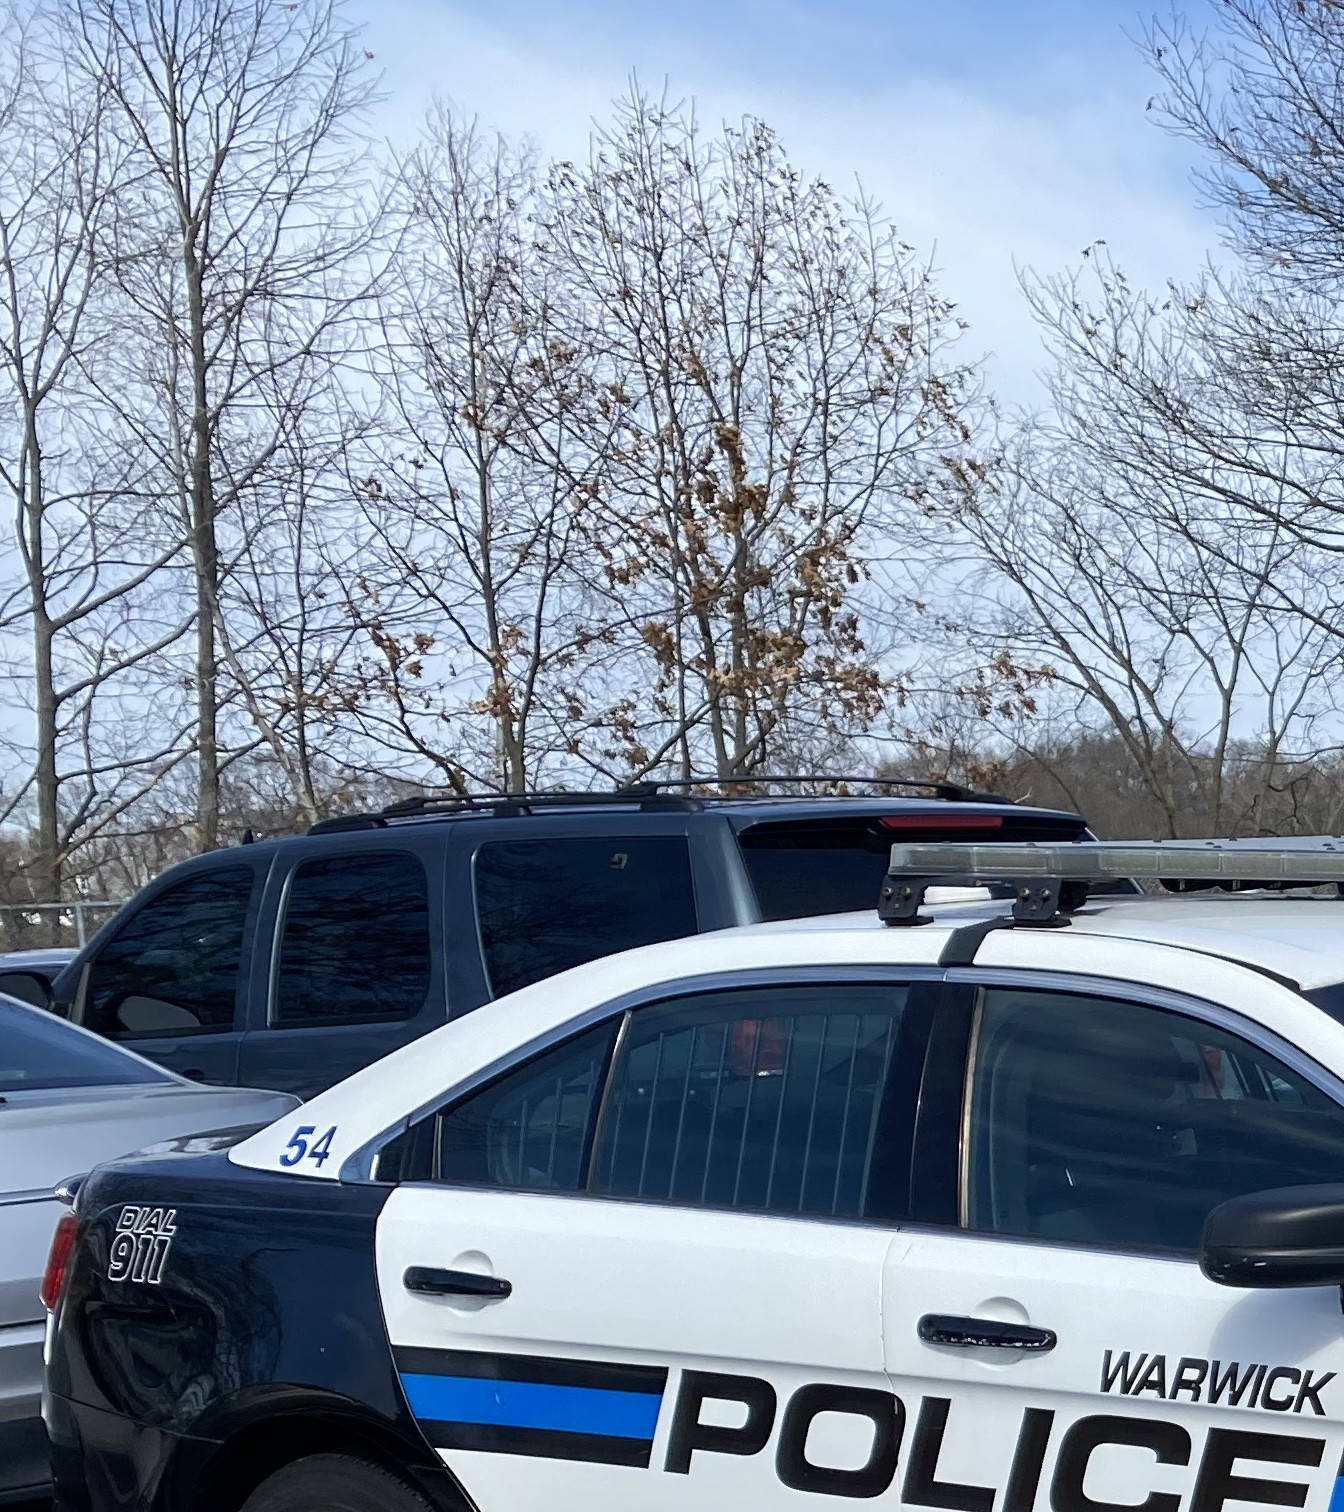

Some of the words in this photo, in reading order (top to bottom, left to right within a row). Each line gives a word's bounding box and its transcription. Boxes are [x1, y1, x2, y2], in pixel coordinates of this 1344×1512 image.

[279, 1125, 339, 1168] 54
[115, 1205, 177, 1235] DIAL
[107, 1232, 172, 1284] 911
[1100, 1349, 1338, 1416] WARWICK
